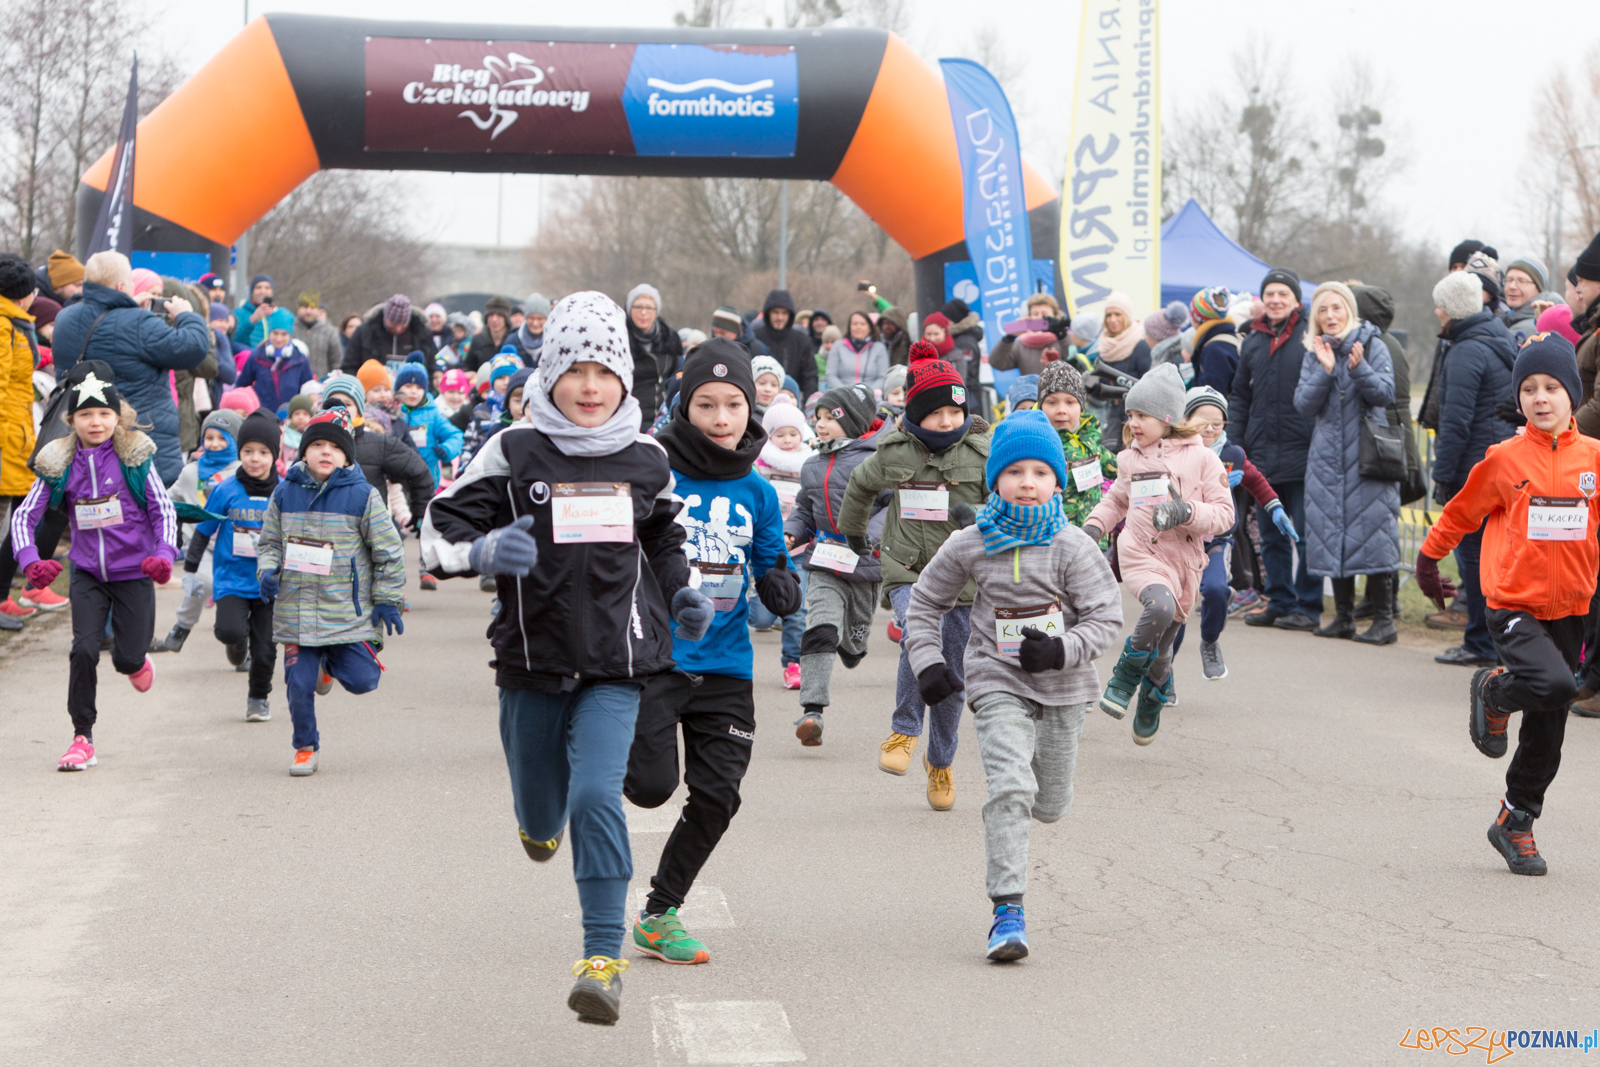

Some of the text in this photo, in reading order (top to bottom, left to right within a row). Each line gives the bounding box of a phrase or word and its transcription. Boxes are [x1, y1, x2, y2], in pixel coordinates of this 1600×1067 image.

[432, 63, 492, 86] Bieg
[402, 82, 591, 113] Czekoladowy
[647, 93, 776, 117] formthotics
[913, 362, 940, 377] DON'T
[1547, 513, 1585, 524] KACPER
